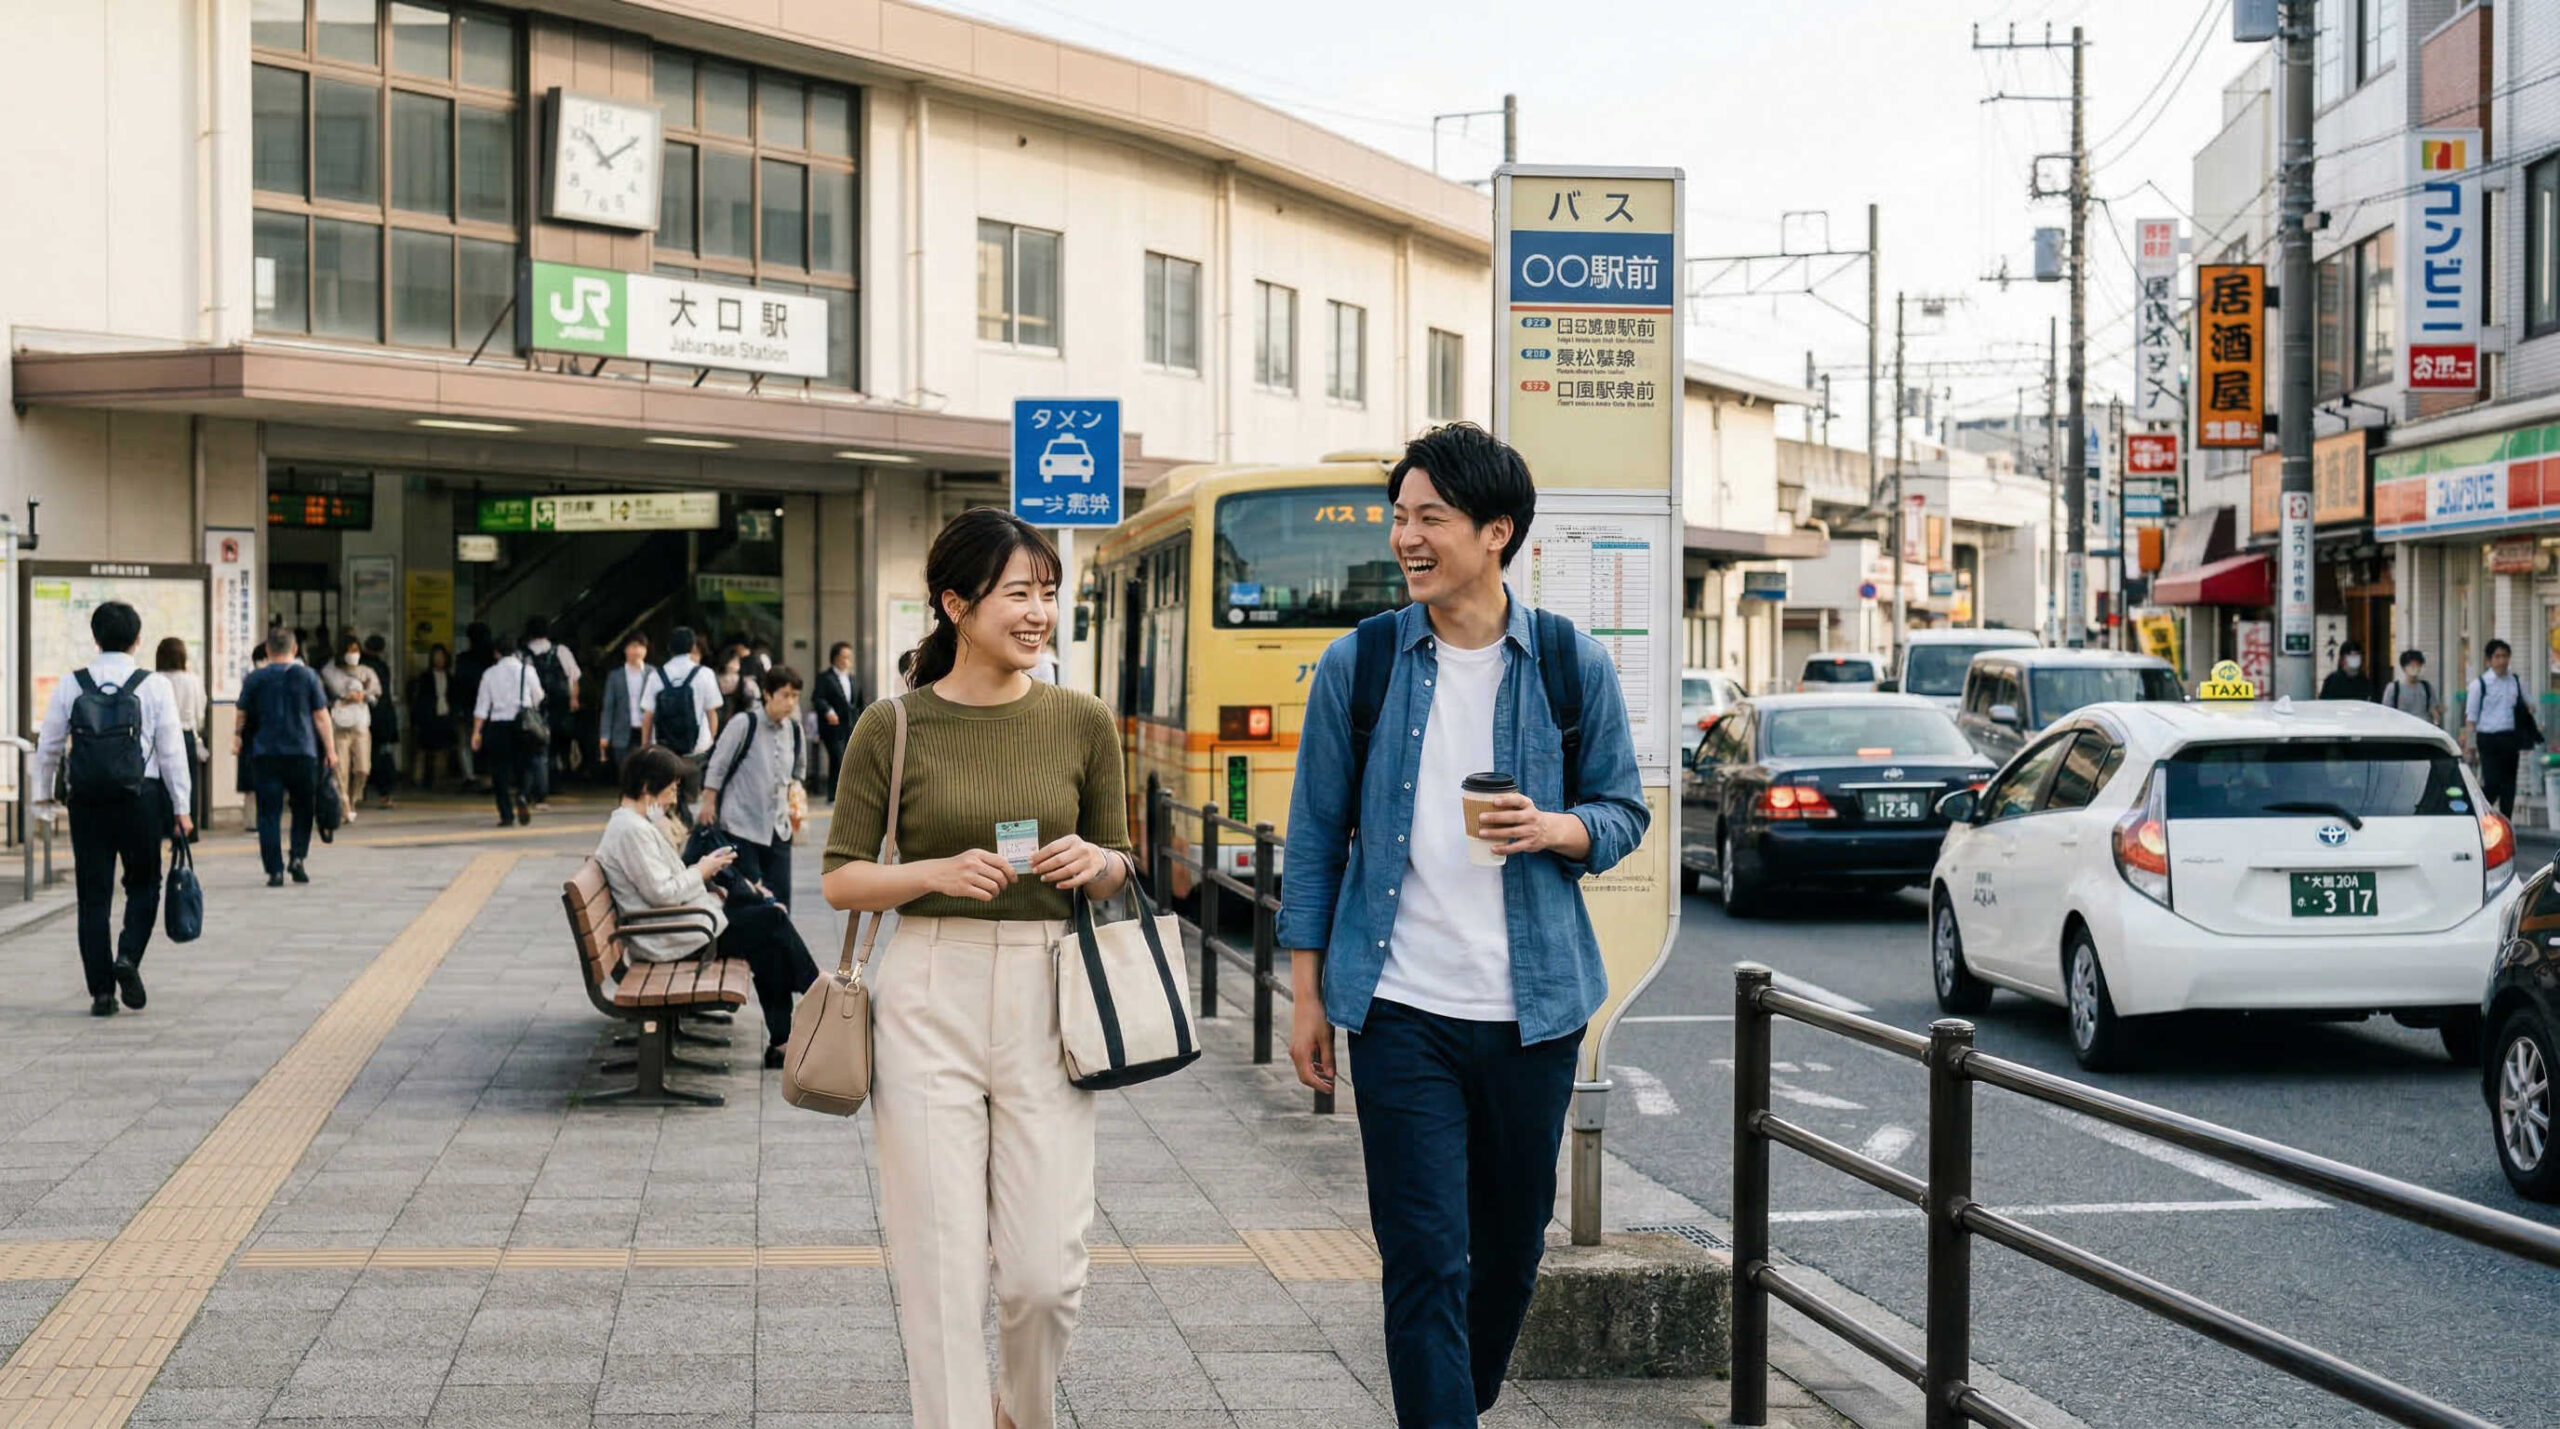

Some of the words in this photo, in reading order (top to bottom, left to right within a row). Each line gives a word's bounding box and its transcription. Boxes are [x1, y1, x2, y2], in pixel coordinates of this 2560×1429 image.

[1548, 189, 1634, 222] バス
[2422, 182, 2462, 330] コンビニ
[550, 275, 611, 327] JR
[669, 288, 788, 340] 大口駅
[2210, 274, 2253, 412] 居酒屋
[1031, 408, 1102, 430] タメン
[1314, 505, 1356, 523] バス
[2209, 684, 2249, 697] TAXI
